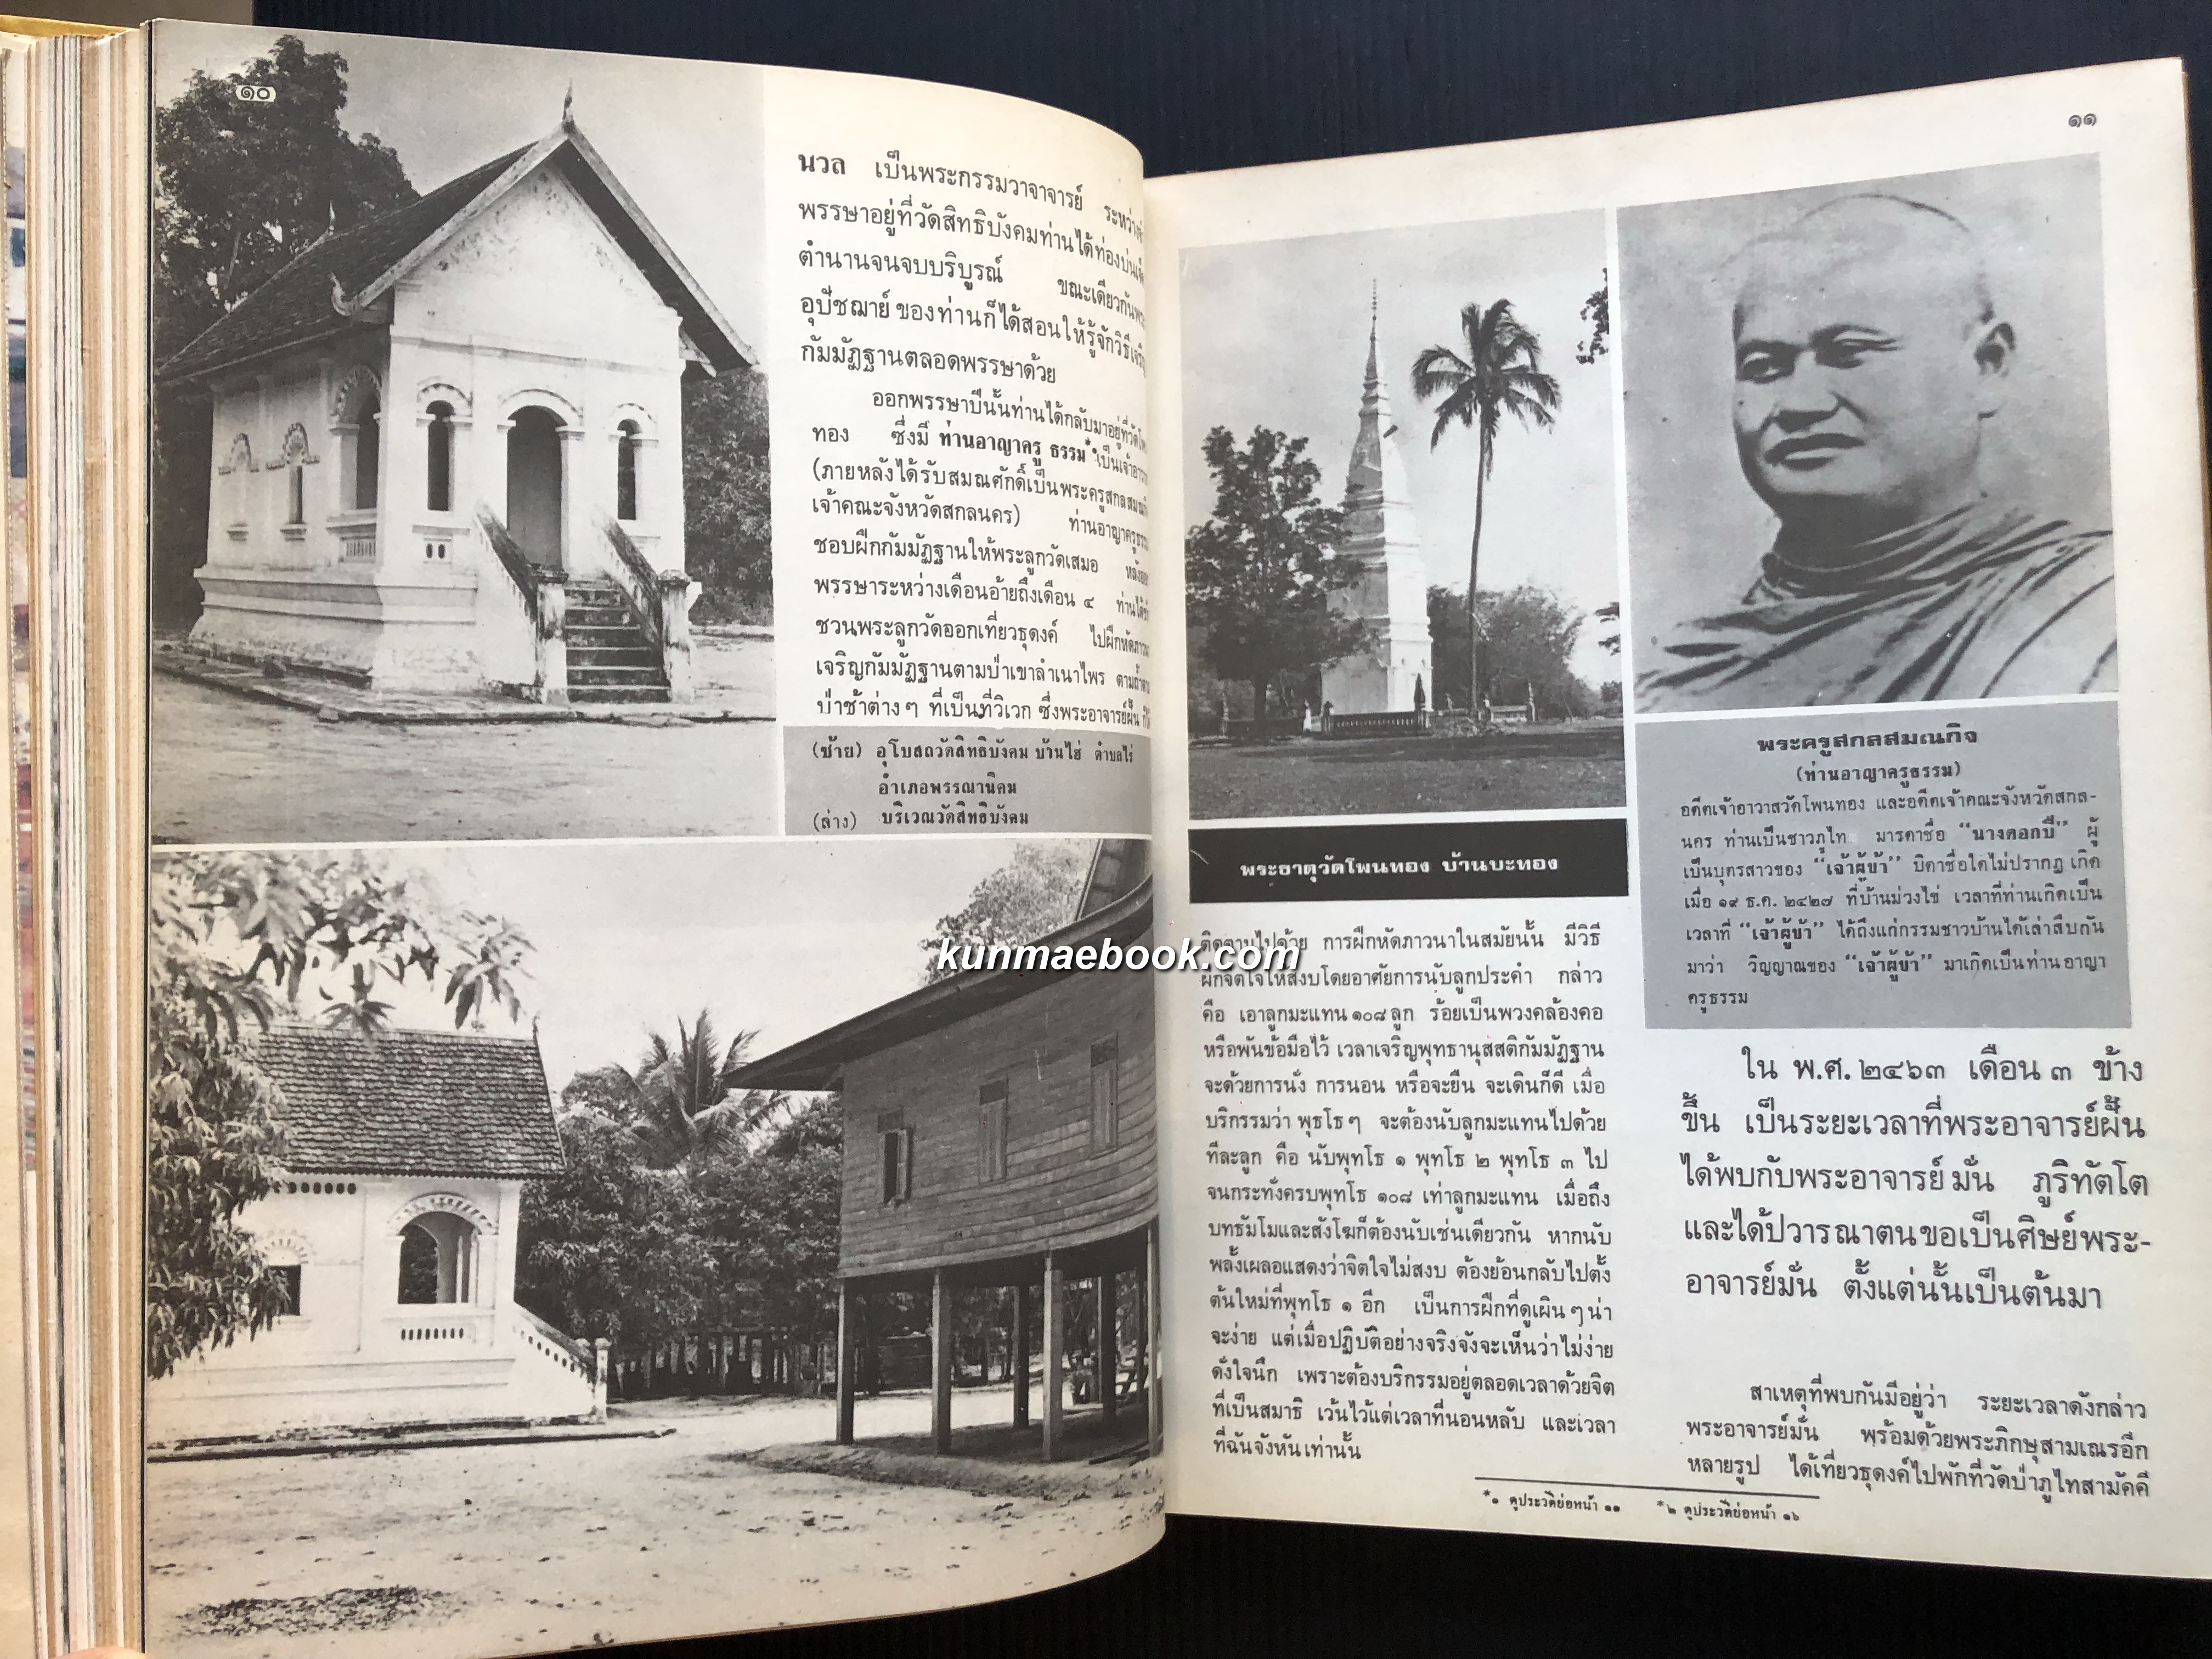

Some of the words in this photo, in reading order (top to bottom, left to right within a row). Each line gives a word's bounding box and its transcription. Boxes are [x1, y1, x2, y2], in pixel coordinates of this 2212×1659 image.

[2068, 113, 2097, 128] ๑๑
[798, 154, 845, 174] นวล
[799, 240, 1003, 291] ตำนานจนจบบริบูรณ์
[801, 334, 1056, 383] กัมมัฏฐานตลอดพรรษาด้วย
[812, 427, 849, 442] ทอง
[891, 415, 930, 446] ซึ่งมี
[939, 420, 1041, 466] ท่านอาญาครู
[812, 488, 1020, 527] เจ้าคณะจังหวัดสกลนคร)
[814, 528, 1098, 575] ชอบฝึกกัมมัฏฐานให้พระลูกวัดเสมอ
[814, 572, 1075, 607] พรรษาระหว่างเดือนอ้ายถึงเดือน
[1084, 597, 1094, 609] ๔
[816, 610, 1058, 651] ชวนพระลูกวัดออกเที่ยวธุดงค์
[877, 735, 1028, 768] อุโบสถวัดสิทธิบังคม
[1757, 723, 1977, 757] พระครูสกลสมณกิจ
[879, 772, 1016, 795] อำเภอพรรณานิคม
[1797, 760, 1960, 788] (ท่านอาญาครูธรรม)
[814, 809, 856, 833] (ล่าง)
[882, 800, 1028, 824] บริเวณวัดสิทธิบังคม
[1681, 794, 1864, 816] อดีตเจ้าอาวาสวัดโพนทอง
[1681, 837, 1712, 849] นคร
[1876, 817, 1945, 843] มารดาชื่อ
[1240, 855, 1430, 882] พระธาตุวัดโพนทอง
[1442, 851, 1558, 872] บ้านบะทอง
[1684, 857, 1802, 886] เป็นบุตรสาวของ
[2071, 848, 2101, 869] เกิด
[1685, 887, 1711, 909] เมื่อ
[1784, 894, 1833, 908] ๒๔๒๗
[1846, 883, 1939, 906] ที่บ้านม่วงไข่
[1955, 878, 2102, 903] เวลาที่ท่านเกิดเป็น
[1323, 919, 1544, 950] การฝึกหัดภาวนาในสมัยนั้น
[1564, 922, 1600, 946] มีวิธี
[1687, 918, 1730, 941] เวลาที่
[1558, 961, 1602, 984] กล่าว
[1688, 954, 1723, 973] มาว่า
[1748, 954, 1835, 976] วิญญาณของ
[1203, 999, 1224, 1022] คือ
[1430, 996, 1602, 1021] ร้อยเป็นพวงคล้องคอ
[1688, 993, 1747, 1014] ครูธรรม
[1204, 1034, 1329, 1058] หรือพันข้อมือไว้
[1741, 1046, 1778, 1080] ใน
[1793, 1057, 1850, 1080] พ.ศ.
[1859, 1059, 1945, 1080] ๒๔๖๓
[1970, 1043, 2041, 1081] เดือน
[2051, 1066, 2072, 1081] ๓
[2092, 1045, 2143, 1081] ข้าง
[1204, 1069, 1306, 1093] จะด้วยการนั่ง
[1316, 1080, 1385, 1093] การนอน
[1395, 1069, 1475, 1093] หรือจะยืน
[1486, 1069, 1563, 1093] จะเดินก็ดี
[1573, 1066, 1605, 1094] เมื่อ
[1206, 1107, 1290, 1128] บริกรรมว่า
[1380, 1106, 1606, 1141] จะต้องนับลูกมะแทนไปด้วย
[1681, 1092, 1720, 1133] ขึ้น
[1206, 1141, 1261, 1175] ทีละลูก
[1276, 1141, 1298, 1165] คือ
[1308, 1143, 1385, 1175] นับพุทโธ
[1396, 1156, 1406, 1166] ๑
[1415, 1145, 1465, 1176] พุทโธ
[1475, 1154, 1489, 1167] ๒
[1499, 1146, 1550, 1177] พุทโธ
[1561, 1159, 1573, 1169] ๓
[1583, 1146, 1607, 1169] ไป
[1207, 1176, 1367, 1211] จนกระทั่งครบพุทโธ
[1378, 1190, 1412, 1204] ๑๐๘
[1423, 1181, 1539, 1214] เท่าลูกมะแทน
[1556, 1178, 1610, 1207] เมื่อถึง
[2033, 1159, 2148, 1208] ภูริทัตโต
[1548, 1222, 1611, 1245] หากนับ
[1457, 1254, 1610, 1283] ต้องย้อนกลับไปตั้ง
[1686, 1260, 1818, 1297] อาจารย์มั่น
[1844, 1259, 2101, 1309] ตั้งแต่นั้นเป็นต้นมา
[1210, 1283, 1331, 1319] ต้นใหม่ที่พุทโธ
[1342, 1302, 1352, 1312] ๑
[1362, 1289, 1385, 1313] อีก
[1211, 1322, 1257, 1345] จะง่าย
[1212, 1389, 1303, 1420] ที่เป็นสมาธิ
[1318, 1397, 1525, 1430] เว้นไว้แต่เวลาที่นอนหลับ
[1543, 1417, 1615, 1434] และเวลา
[1750, 1373, 1946, 1419] สาเหตุที่พบกันมีอยู่ว่า
[1977, 1391, 2147, 1419] ระยะเวลาดังกล่าว
[1686, 1412, 1819, 1441] พระอาจารย์มั่น
[1860, 1418, 2148, 1464] พร้อมด้วยพระภิกษุสามเณรอีก
[1688, 1454, 1760, 1485] หลายรูป
